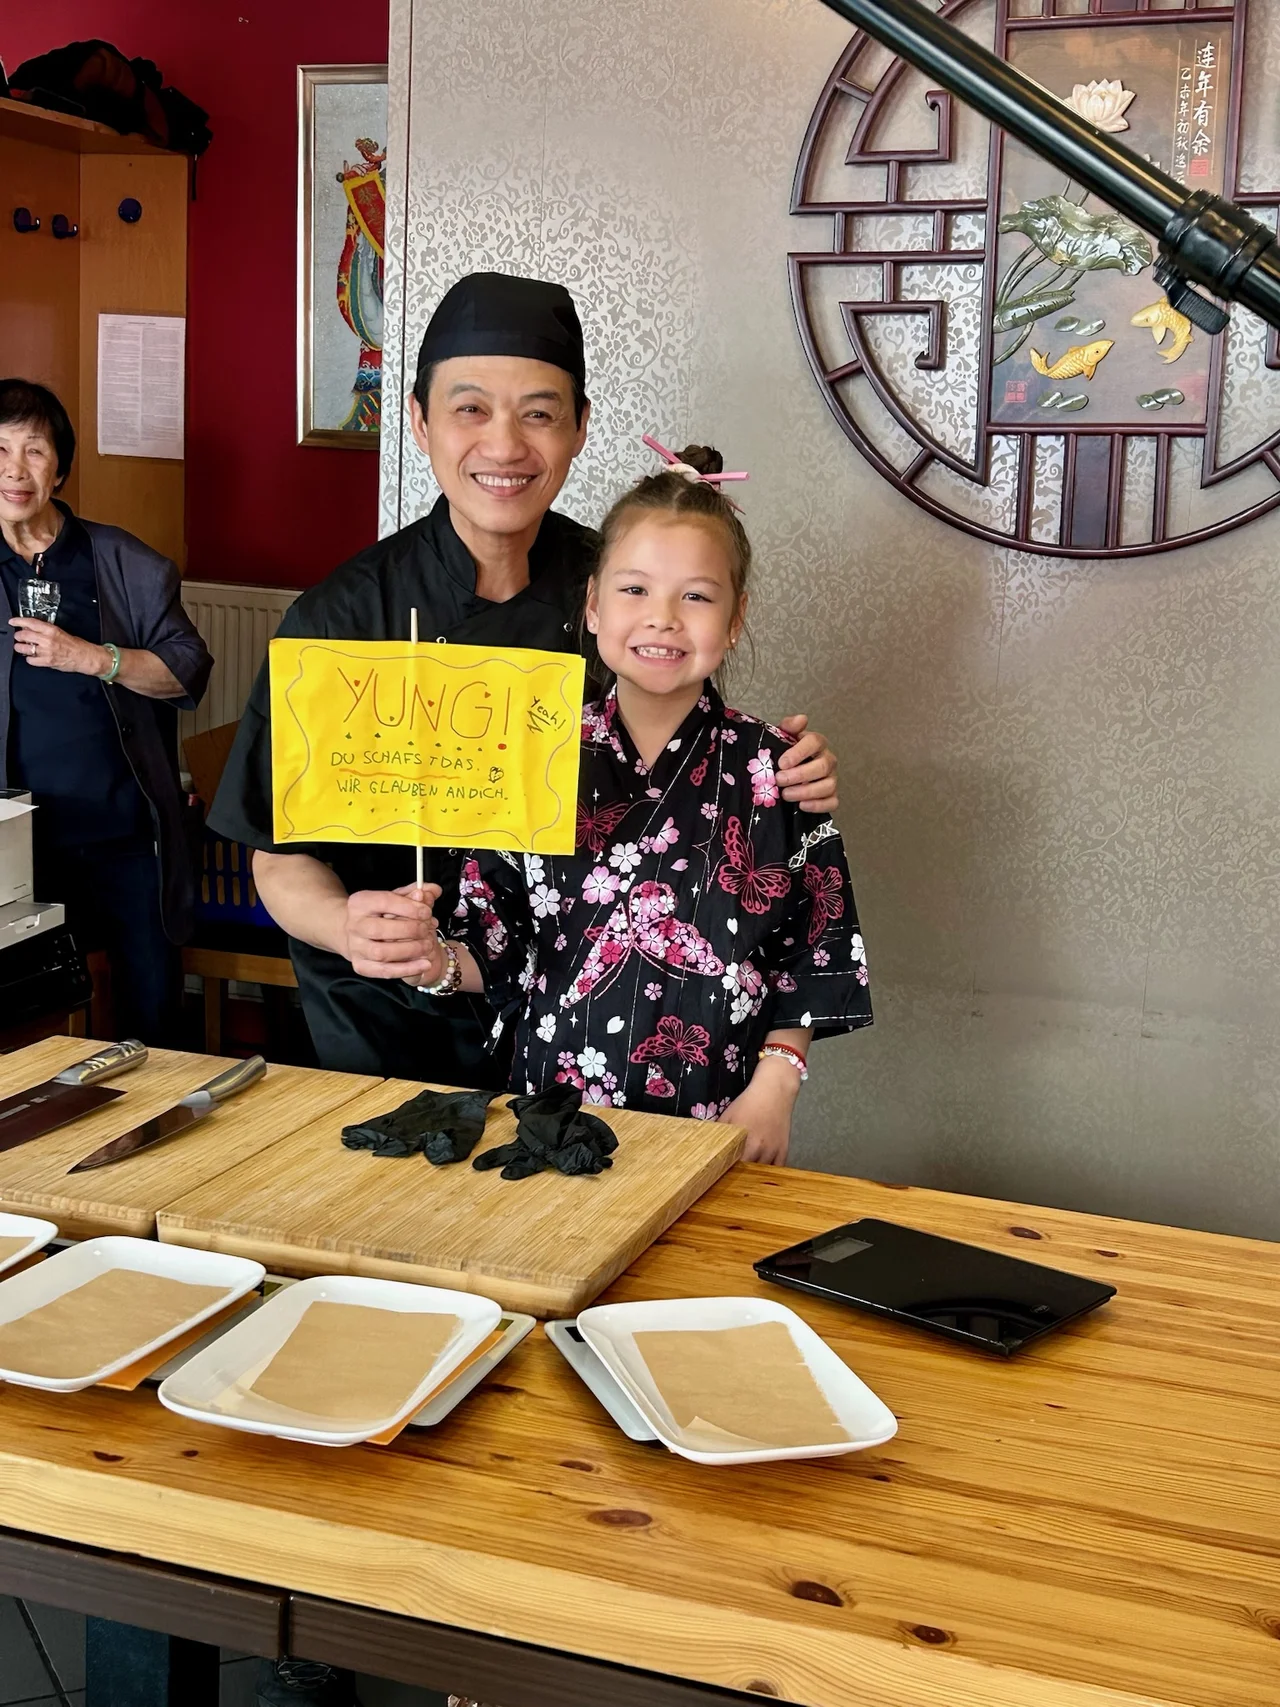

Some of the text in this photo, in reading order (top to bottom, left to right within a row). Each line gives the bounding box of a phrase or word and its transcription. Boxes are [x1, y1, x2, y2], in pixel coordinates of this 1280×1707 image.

[530, 695, 566, 732] Yeah!
[331, 751, 355, 766] DU
[369, 779, 438, 797] GLAUBEN
